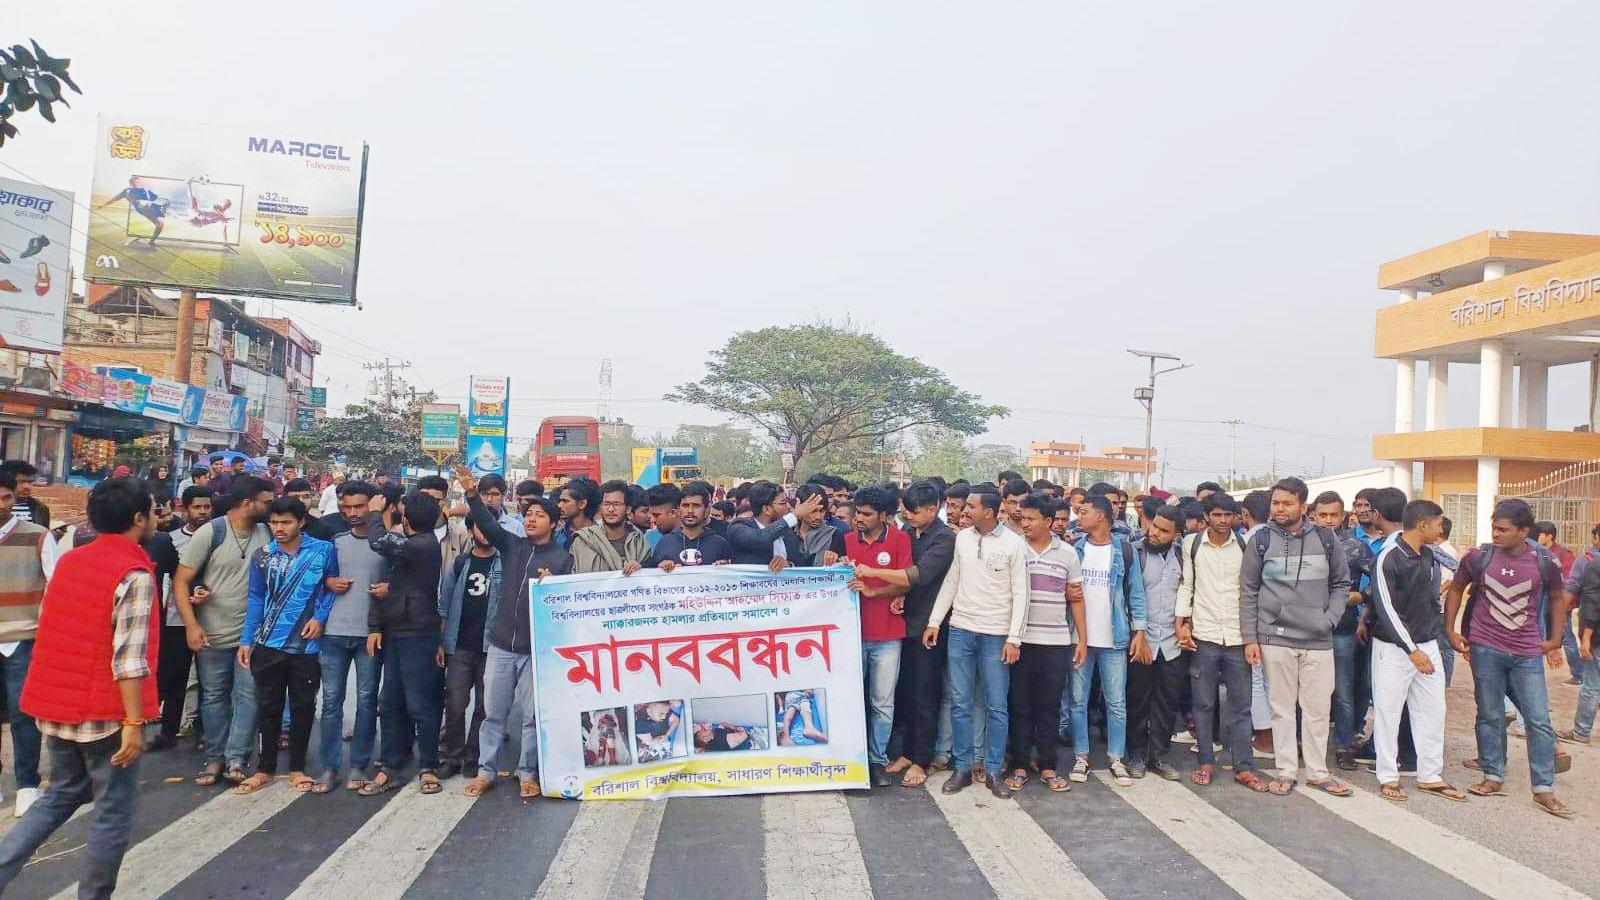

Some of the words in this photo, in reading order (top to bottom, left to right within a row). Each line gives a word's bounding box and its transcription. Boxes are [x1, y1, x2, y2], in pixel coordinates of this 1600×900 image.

[248, 136, 351, 161] MARCEL
[304, 160, 350, 172] Television
[1450, 297, 1509, 327] বরিশাল
[467, 571, 491, 597] 3
[543, 593, 572, 606] বরিশাল
[574, 588, 628, 603] বিশ্ববিদ্যালয়ের
[630, 585, 652, 597] গণিত
[653, 584, 685, 597] বিভাগের
[688, 582, 738, 594] ২০১২-২০১৩
[808, 572, 835, 584] শিক্ষার্থী
[551, 607, 606, 622] বিশ্ববিদ্যালয়ের
[608, 602, 646, 616] ছাত্রলীগের
[648, 600, 676, 612] সংগঠক
[677, 595, 722, 611] মহিউদ্দিন
[768, 589, 801, 603] সিফাত
[819, 588, 838, 599] উপর
[601, 616, 659, 630] ন্যাক্কারজনক
[660, 612, 695, 626] হামলার
[698, 609, 739, 623] প্রতিবাদে
[742, 606, 778, 620] সমাবেশ
[783, 608, 790, 616] ও
[553, 624, 841, 695] মানববন্ধন
[591, 778, 641, 796] বরিশাল
[645, 771, 722, 789] বিশ্ববিদ্যালয়,
[726, 767, 773, 782] সাধারণ
[777, 761, 848, 781] শিক্ষার্থীবৃন্দ
